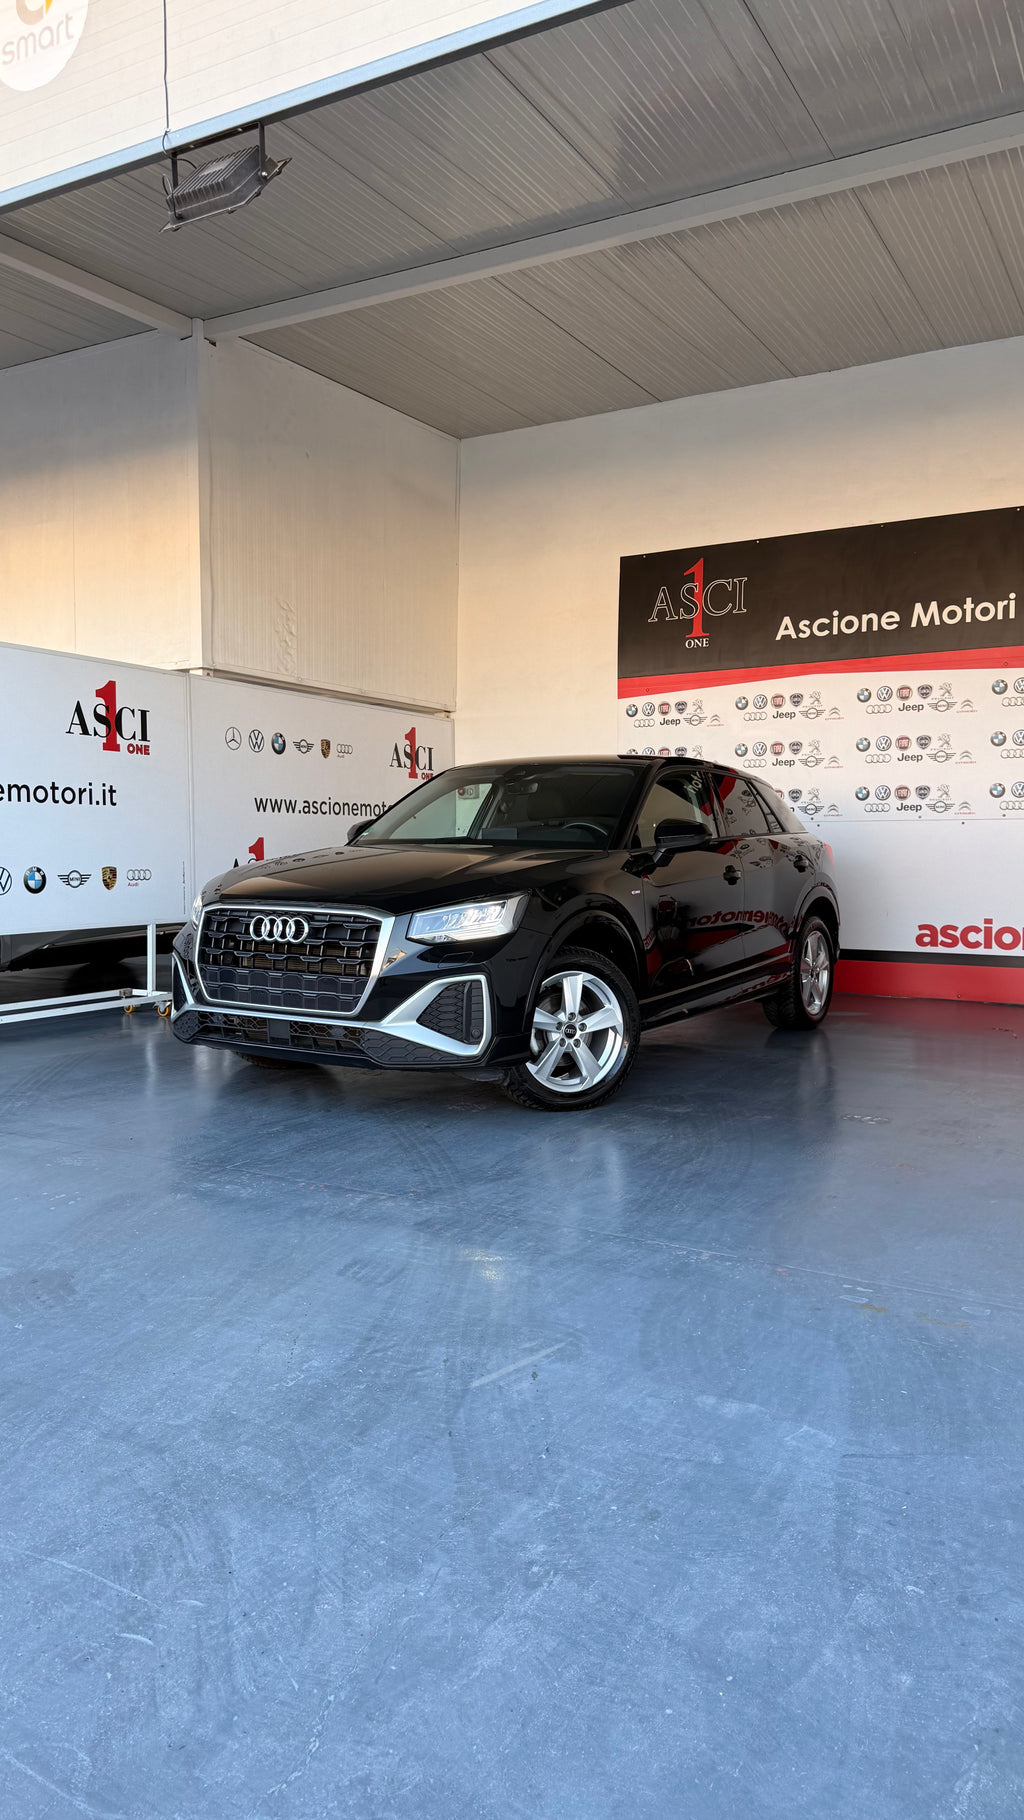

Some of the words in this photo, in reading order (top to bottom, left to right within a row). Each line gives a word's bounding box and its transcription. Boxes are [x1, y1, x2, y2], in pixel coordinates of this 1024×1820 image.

[2, 13, 74, 66] smart
[775, 610, 900, 641] Ascione
[911, 592, 1017, 628] Motori
[685, 638, 710, 649] ONE
[898, 703, 924, 713] Jeep
[772, 710, 796, 720] Jeep
[659, 717, 681, 727] Jeep
[127, 743, 151, 756] ONE
[771, 758, 796, 768] Jeep
[897, 753, 924, 763] Jeep
[254, 797, 394, 818] www.ascionemot
[896, 803, 923, 812] Jeep
[915, 918, 1024, 951] ascio
